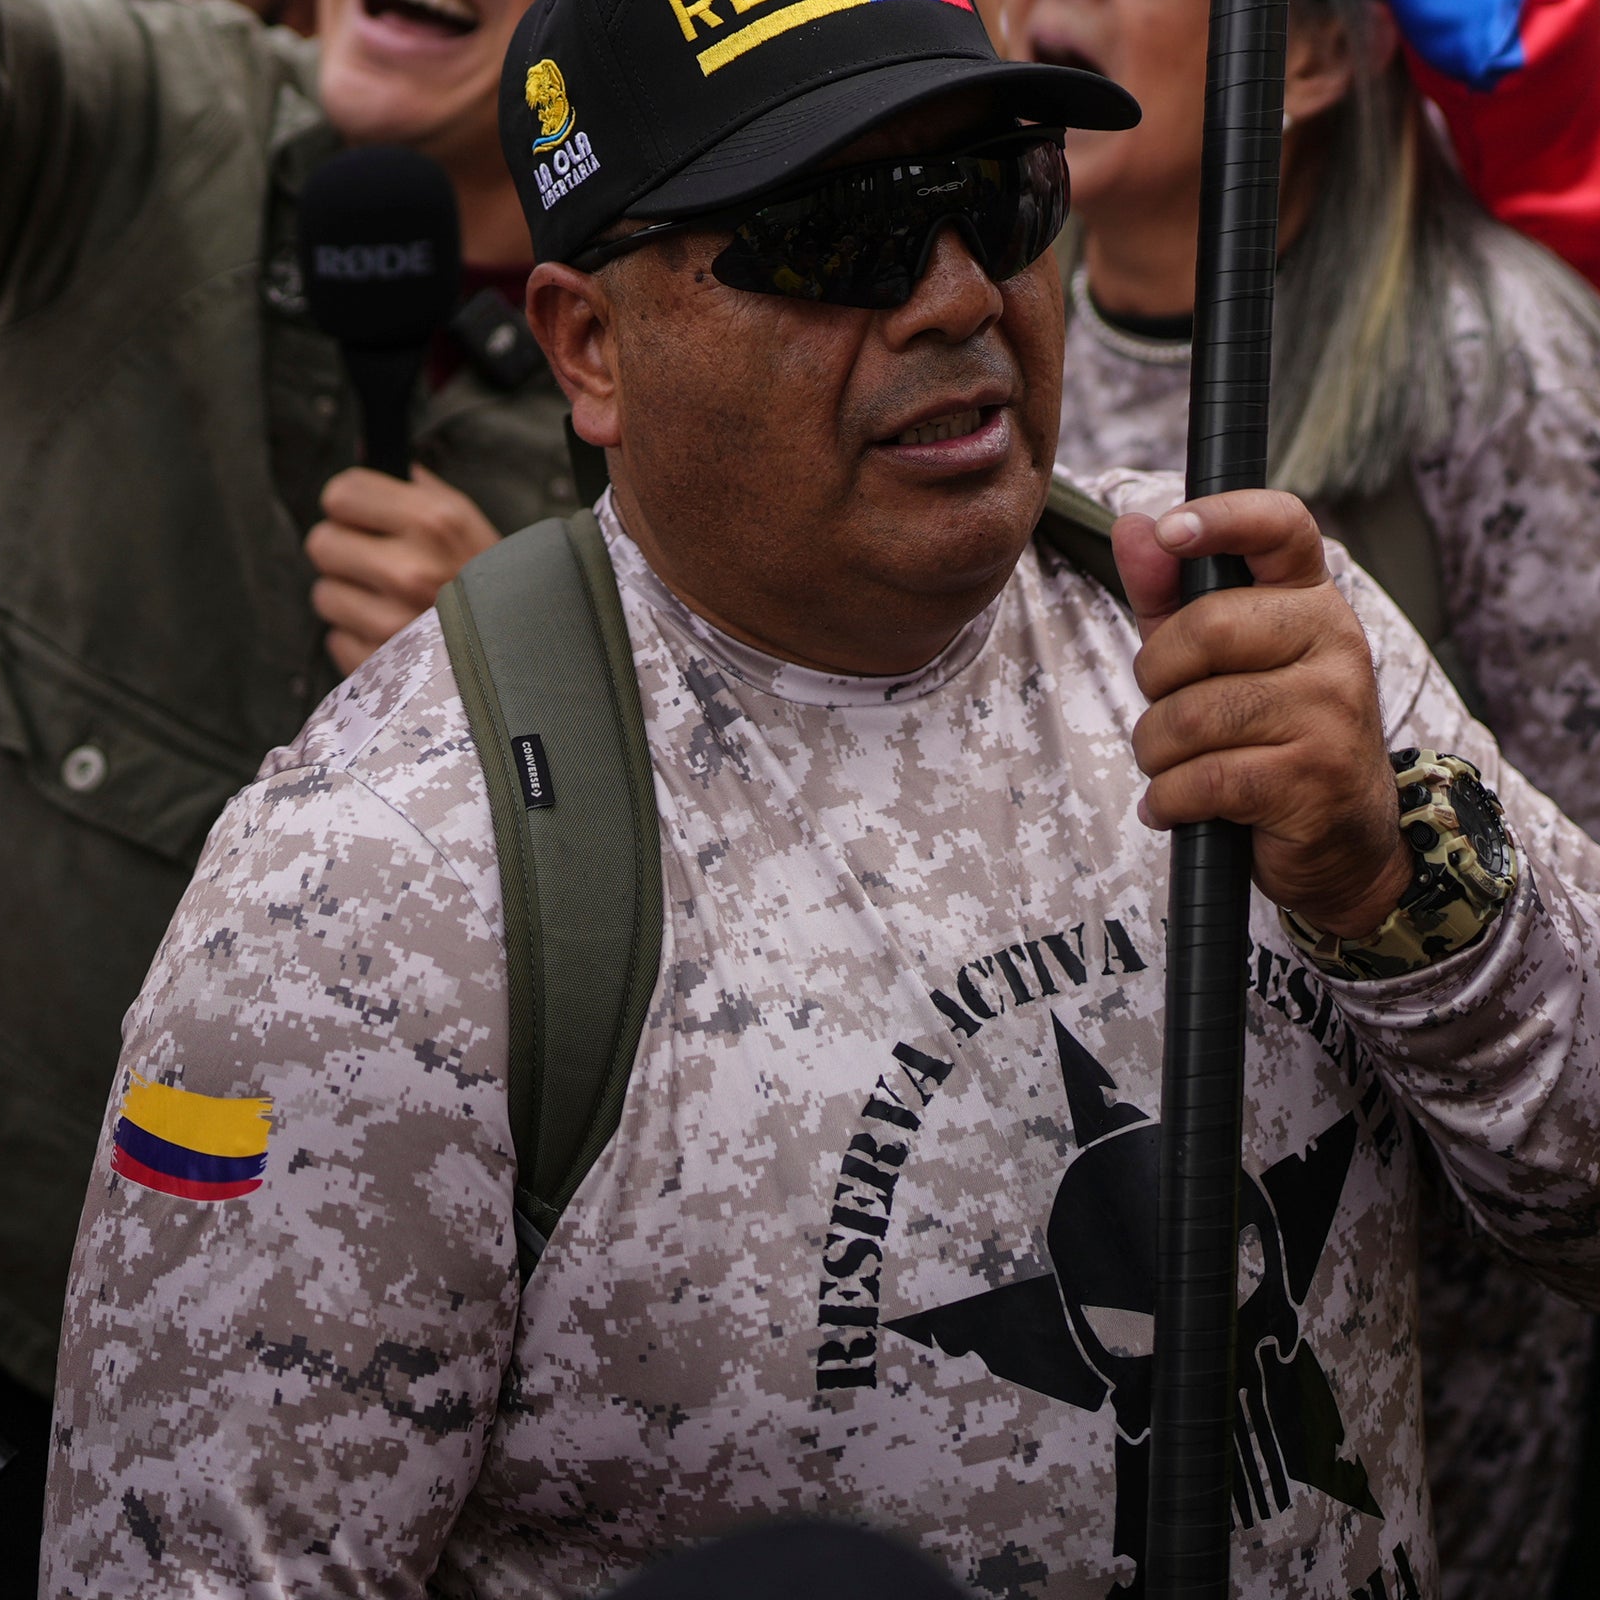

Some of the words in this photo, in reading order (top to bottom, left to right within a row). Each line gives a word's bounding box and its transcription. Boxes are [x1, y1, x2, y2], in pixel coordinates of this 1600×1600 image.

[533, 163, 554, 194] LA
[553, 131, 593, 176] OLA
[540, 153, 601, 211] LIBERTARIA
[522, 741, 541, 789] CONVERSE
[816, 1040, 956, 1391] RESERVA
[929, 919, 1149, 1048] ACTIVA
